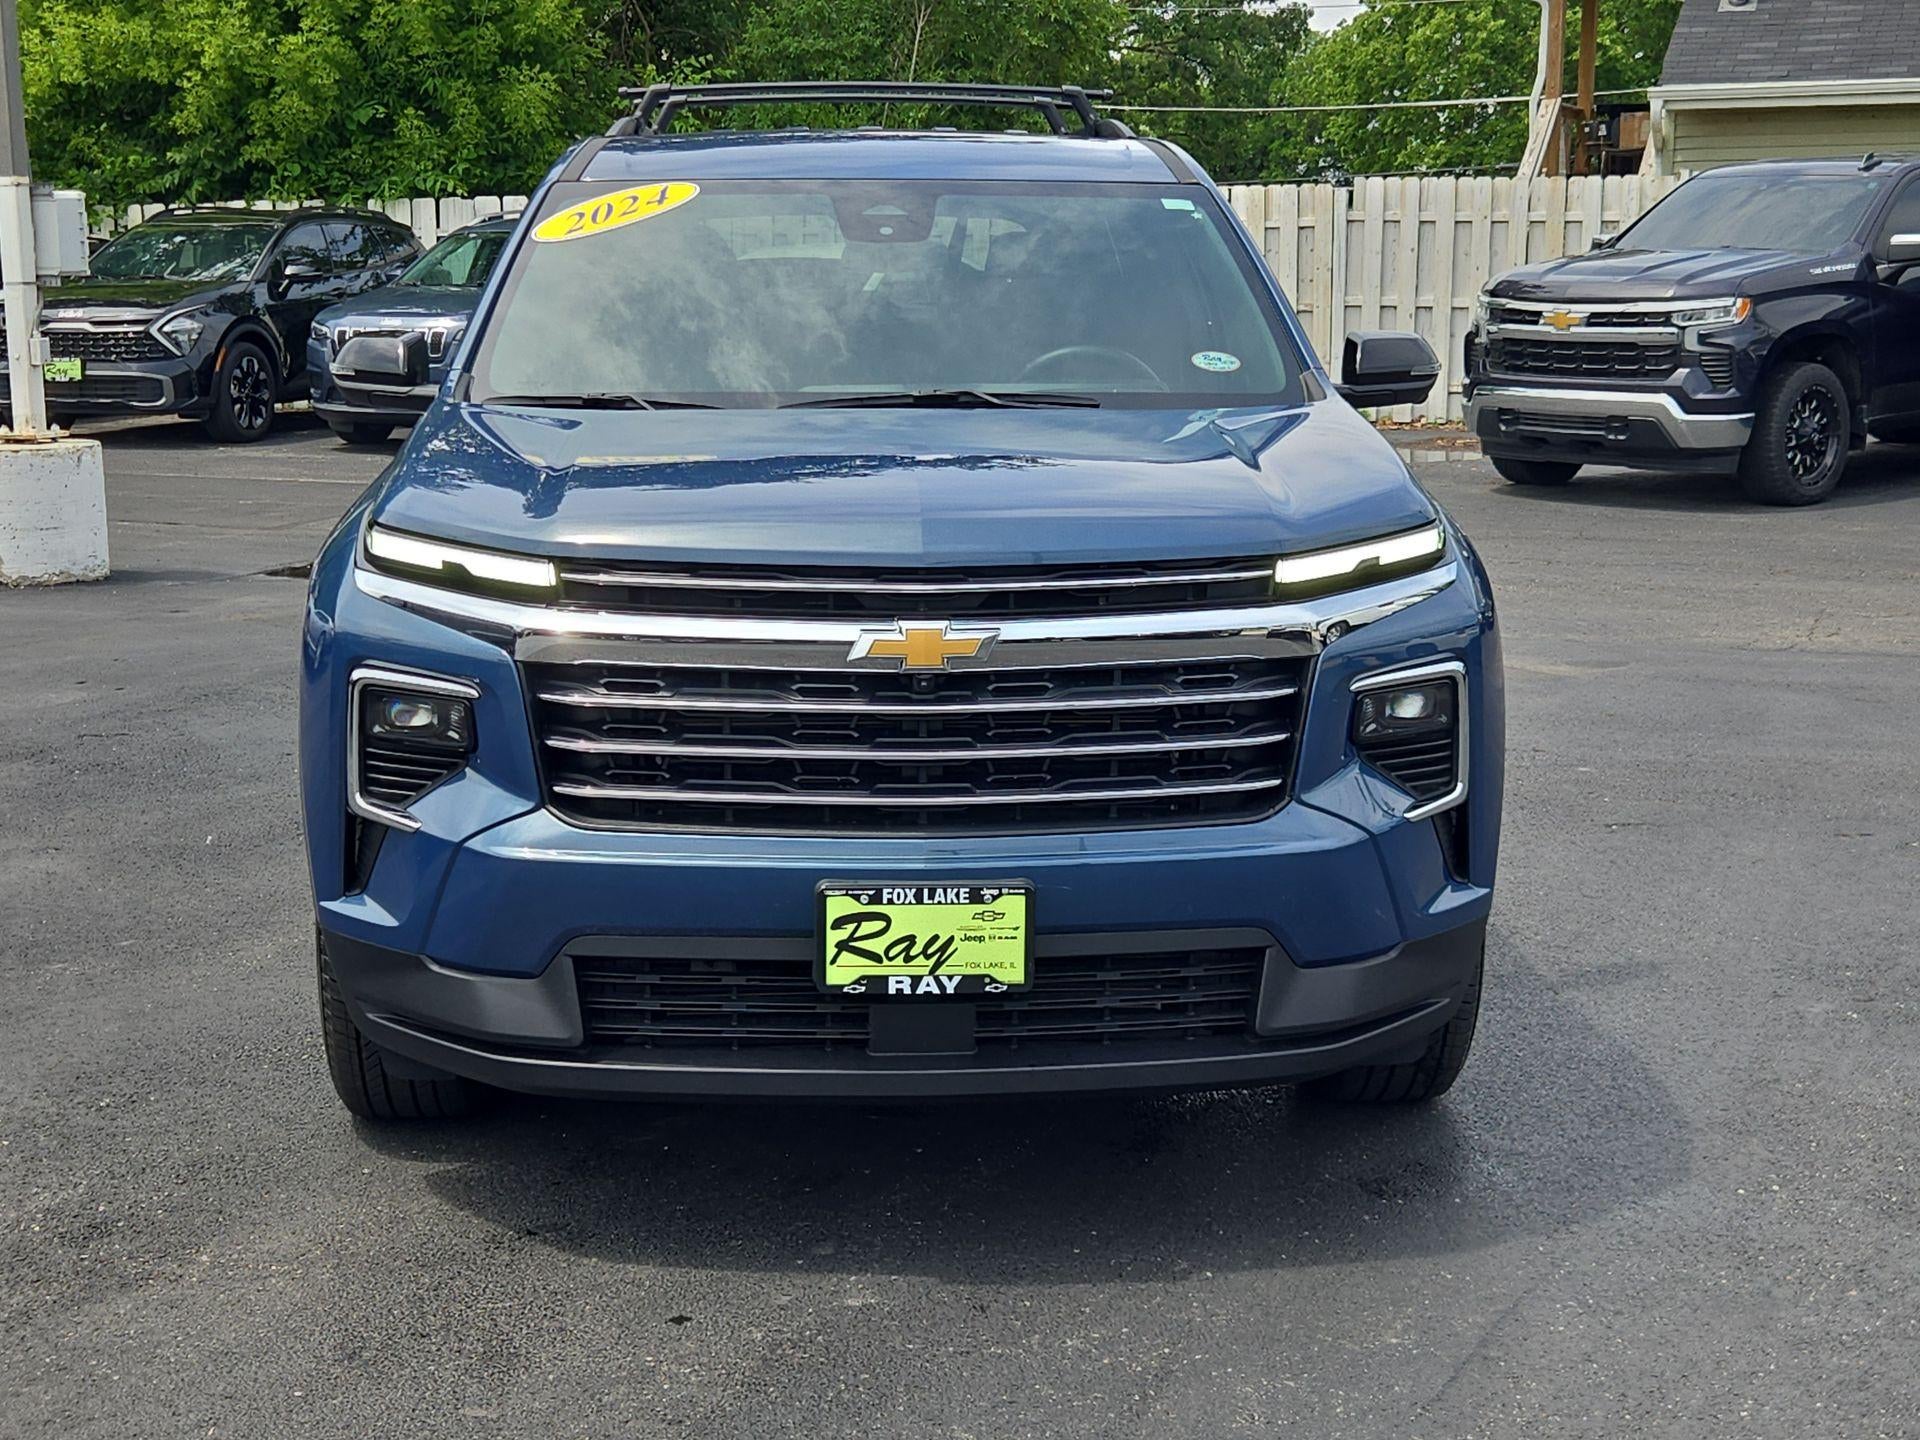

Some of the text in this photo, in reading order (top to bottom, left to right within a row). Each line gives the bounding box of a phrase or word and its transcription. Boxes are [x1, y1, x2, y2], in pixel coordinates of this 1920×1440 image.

[565, 184, 669, 235] 2024
[45, 363, 69, 378] Ray
[882, 887, 970, 904] FOX LAKE
[830, 911, 958, 976] Ray
[960, 933, 986, 944] Jeep
[965, 961, 981, 969] FOX
[887, 975, 963, 995] RAY
